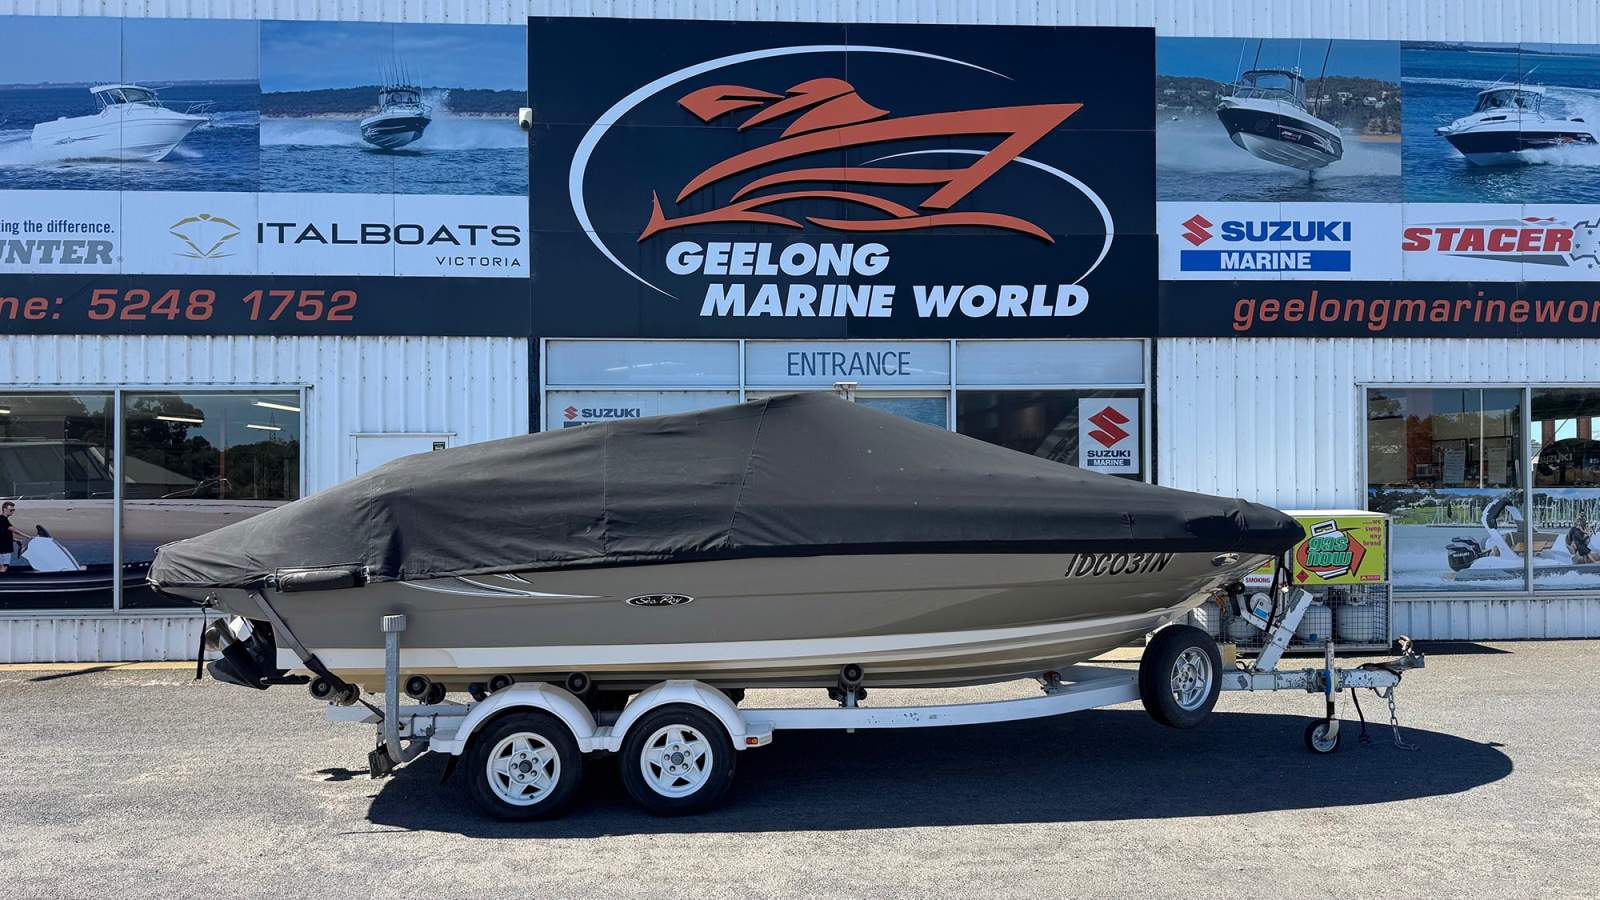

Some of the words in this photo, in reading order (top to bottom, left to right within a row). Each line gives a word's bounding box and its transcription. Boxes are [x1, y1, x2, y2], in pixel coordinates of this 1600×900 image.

[0, 220, 20, 235] ing
[23, 219, 43, 233] the
[47, 219, 115, 233] difference.
[258, 223, 520, 247] ITALBOATS
[1221, 221, 1351, 242] SUZUKI
[1402, 227, 1573, 252] STACER
[0, 239, 114, 265] NTER
[436, 256, 521, 267] VICTORIA
[666, 242, 889, 276] GEELONG
[1221, 252, 1311, 270] MARINE
[88, 289, 216, 321] 5248
[242, 290, 358, 321] 1752
[700, 284, 895, 318] MARINE
[913, 285, 1089, 318] WORLD
[786, 351, 911, 377] ENTRANCE
[582, 408, 640, 418] SUZUKI
[1087, 450, 1131, 458] SUZUKI
[1308, 536, 1349, 552] gas
[1306, 548, 1352, 566] now
[636, 596, 657, 605] Sea
[660, 595, 682, 605] Ray
